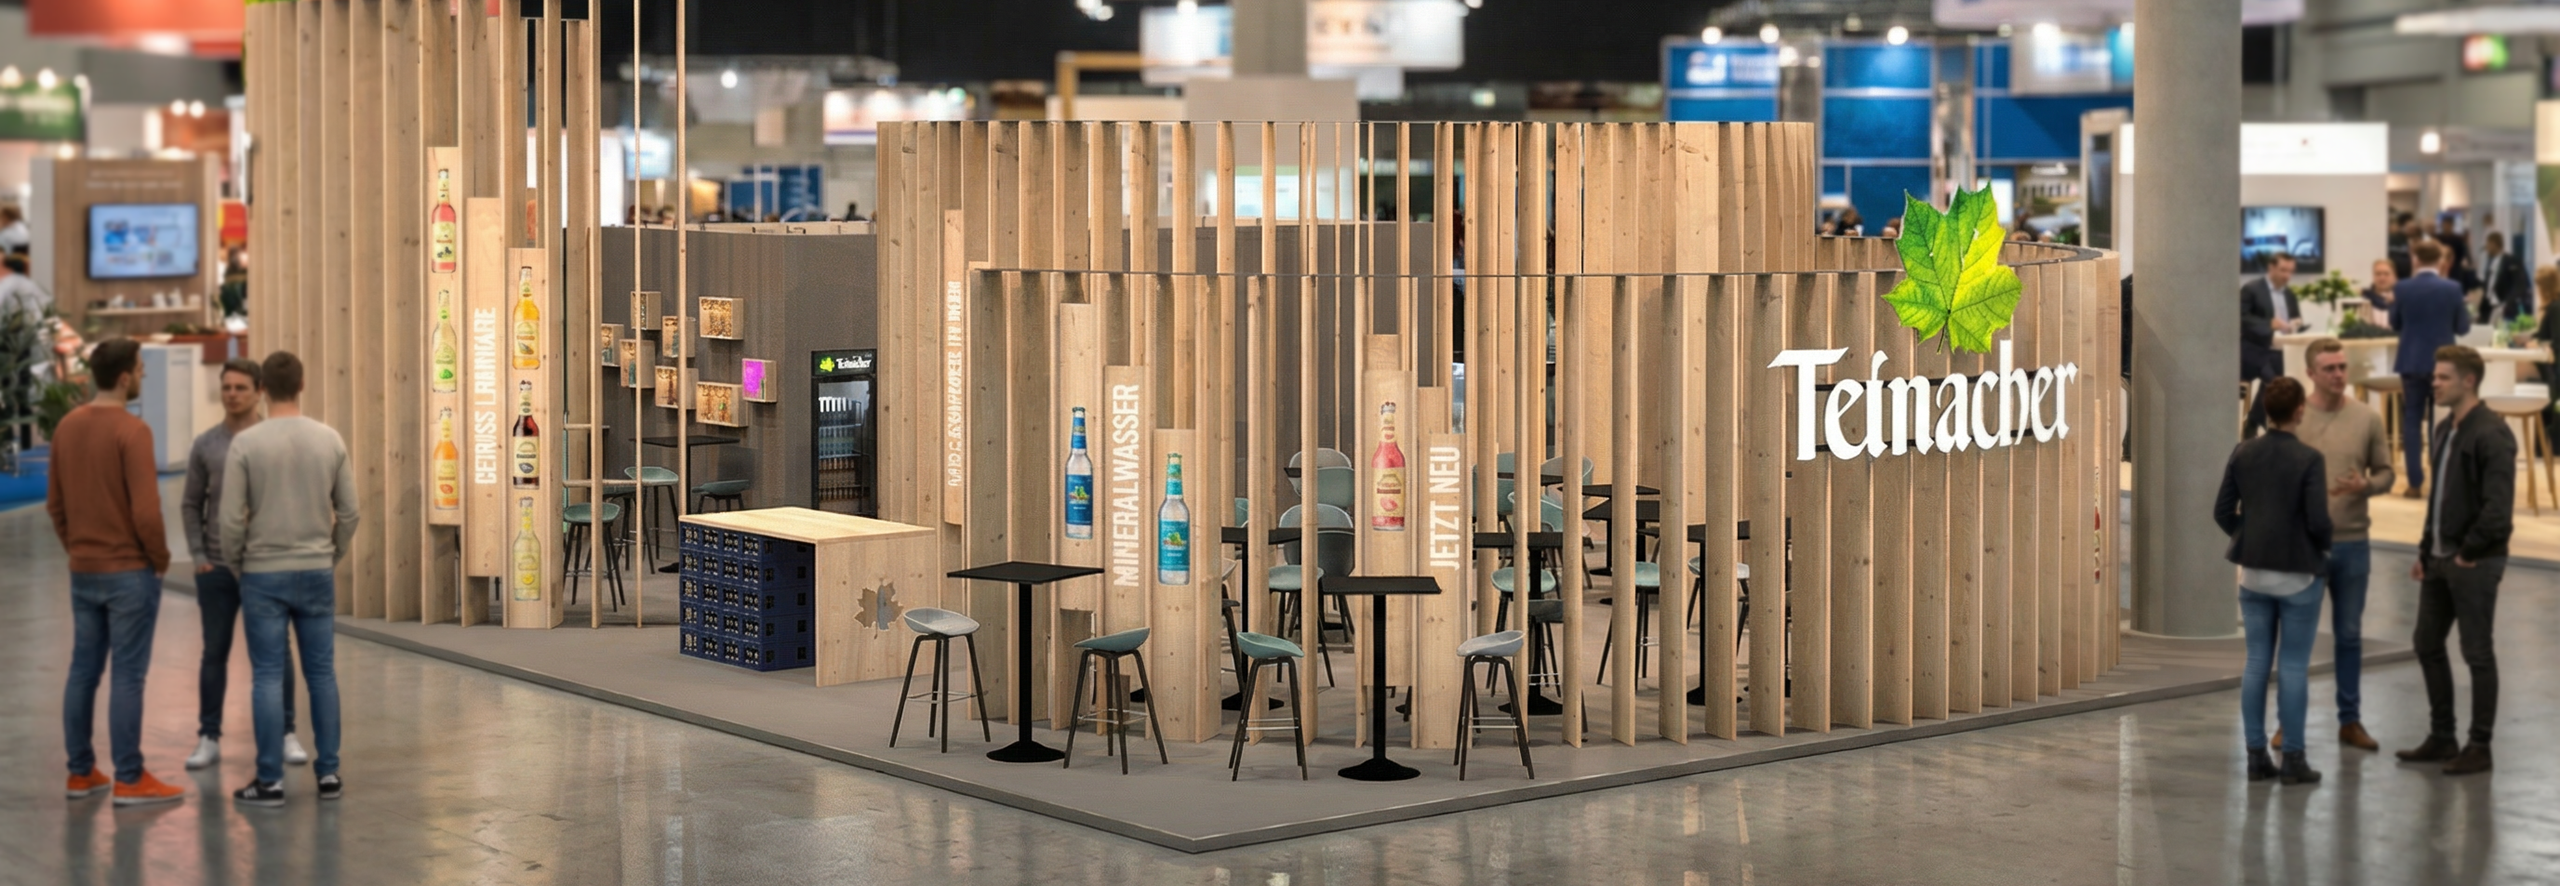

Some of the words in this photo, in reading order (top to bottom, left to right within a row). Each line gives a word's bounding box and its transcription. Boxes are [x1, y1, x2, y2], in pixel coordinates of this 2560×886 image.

[1767, 339, 2079, 461] Teinacher
[1112, 385, 1139, 587] MINERALWASSER
[1429, 446, 1460, 494] NEU
[1429, 500, 1460, 571] JETZT
